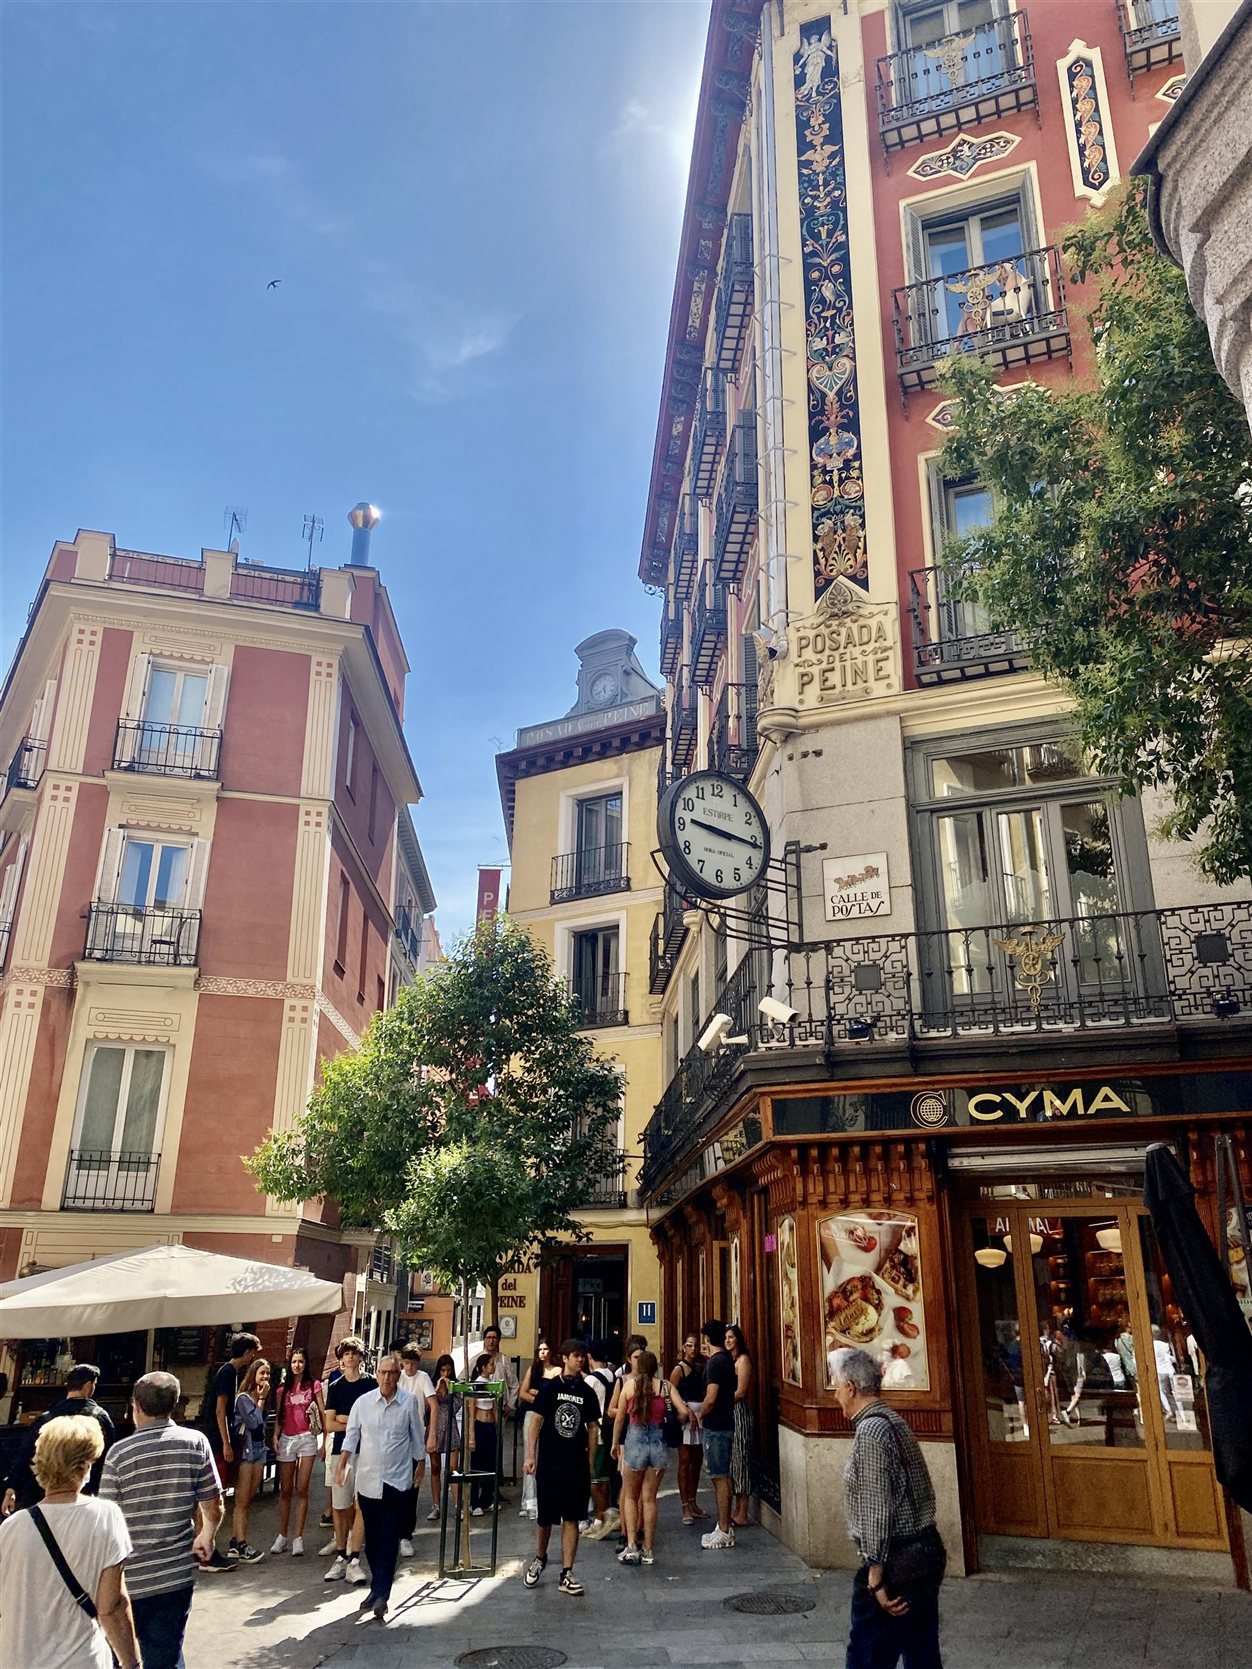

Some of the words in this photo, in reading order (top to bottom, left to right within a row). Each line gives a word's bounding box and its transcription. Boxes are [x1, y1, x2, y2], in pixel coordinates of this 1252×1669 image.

[796, 620, 887, 658] POSADA
[826, 651, 858, 665] DEL
[797, 655, 891, 695] PEINE
[525, 723, 583, 745] POSADA
[602, 702, 649, 723] PEINE
[695, 785, 706, 801] 11
[710, 783, 724, 799] 12
[682, 797, 695, 812] 10
[732, 793, 738, 808] 1
[702, 807, 734, 823] ESTIRPE
[744, 811, 753, 826] 2
[677, 816, 686, 832] 9
[683, 840, 692, 855] 8
[697, 859, 706, 874] 7
[745, 855, 754, 870] 4
[715, 869, 724, 884] 6
[733, 867, 742, 882] 5
[830, 892, 869, 905] CALLE
[870, 890, 882, 901] DE
[831, 900, 885, 918] POSTAS
[967, 1086, 1132, 1121] CYMA
[501, 1278, 517, 1291] del
